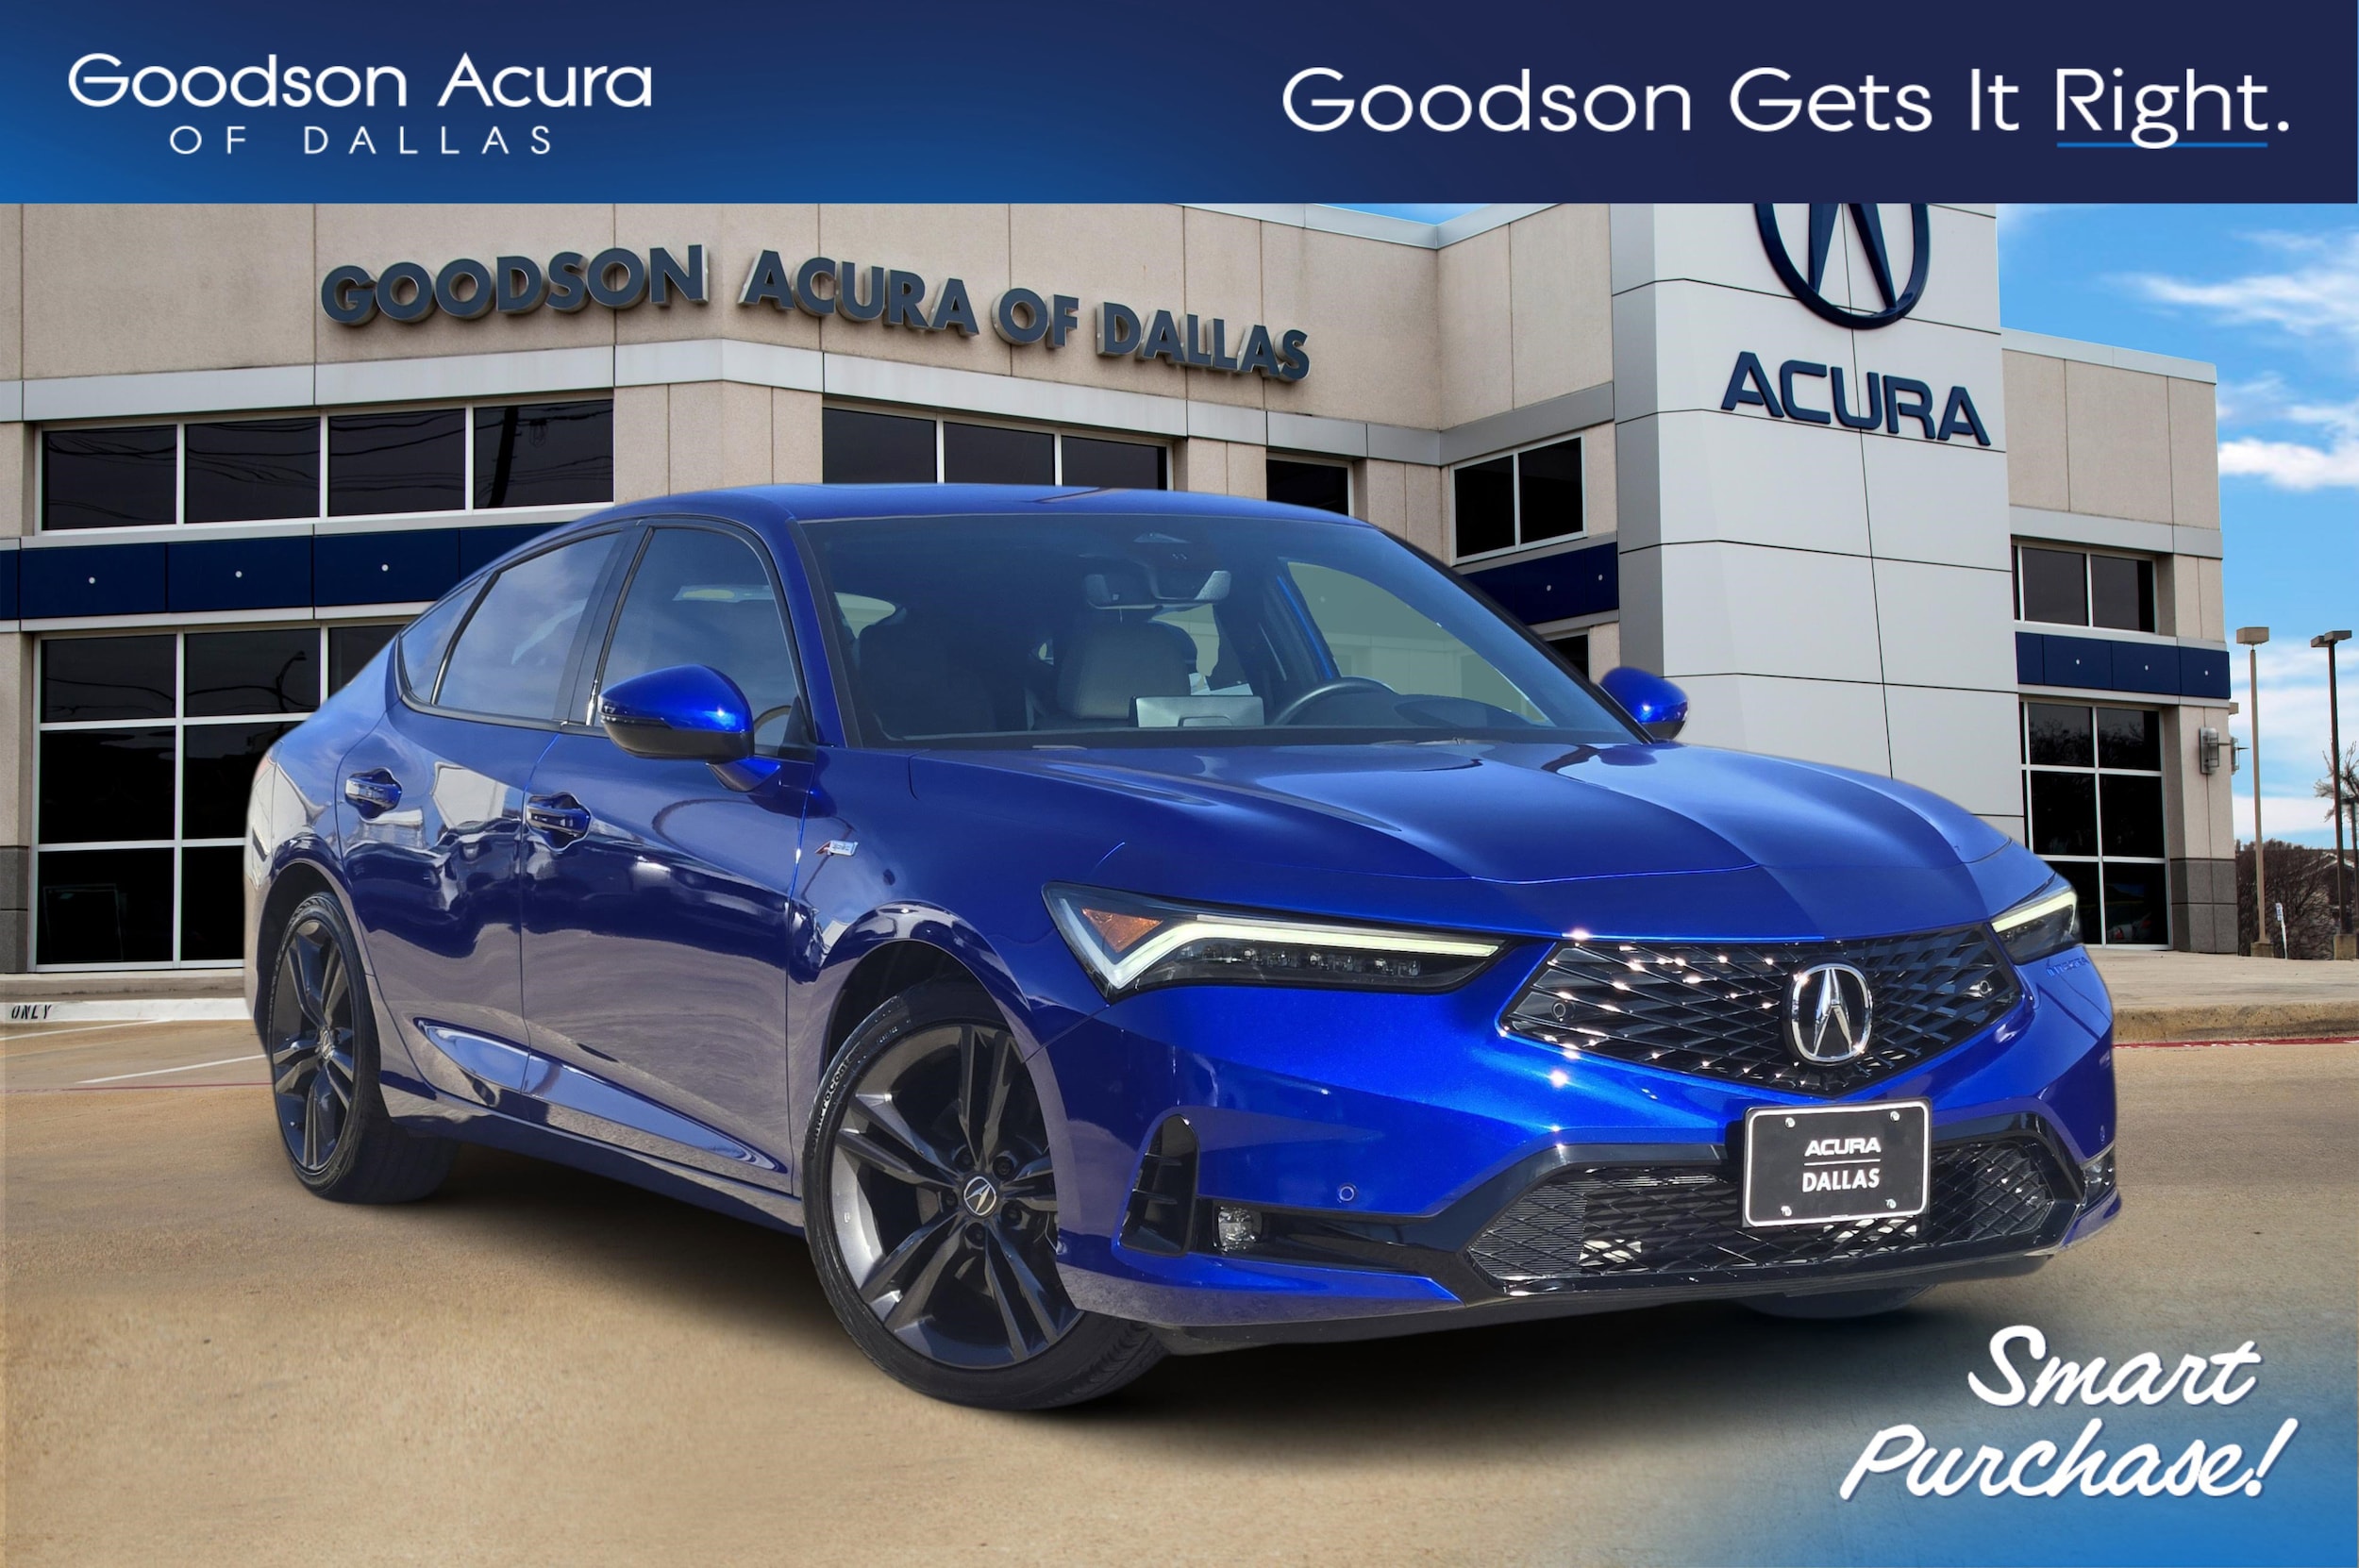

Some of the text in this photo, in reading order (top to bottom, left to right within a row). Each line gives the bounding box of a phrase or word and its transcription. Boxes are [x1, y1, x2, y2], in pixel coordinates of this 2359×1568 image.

[321, 243, 1310, 381] GOODSON ACURA OF DALLAS
[1721, 350, 1992, 446] ACURA
[11, 1004, 52, 1019] ONLY
[1804, 1136, 1882, 1158] ACURA
[1801, 1167, 1881, 1193] DALLAS
